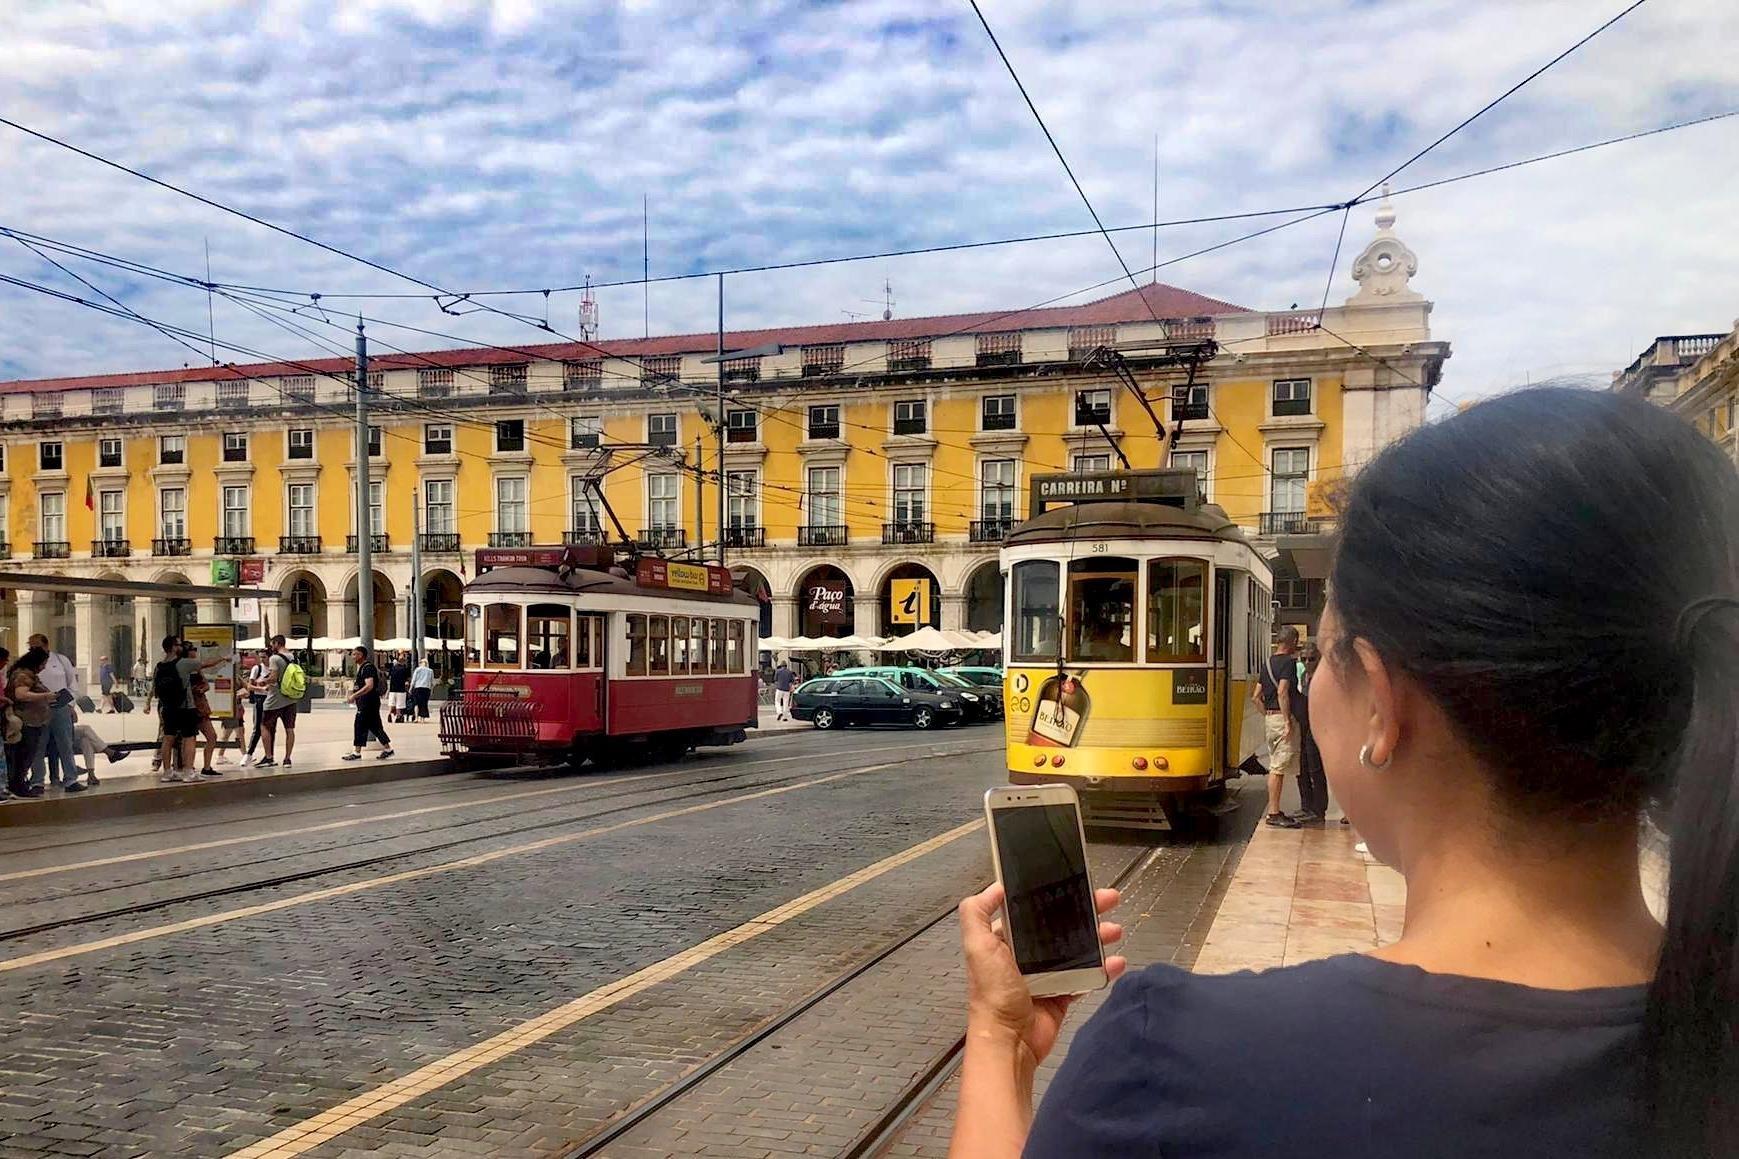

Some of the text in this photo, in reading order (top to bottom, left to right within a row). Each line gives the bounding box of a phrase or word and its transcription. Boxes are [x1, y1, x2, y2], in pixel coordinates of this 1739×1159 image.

[1041, 480, 1103, 495] CARREIRA
[1092, 543, 1108, 552] 581
[809, 586, 843, 602] Paço
